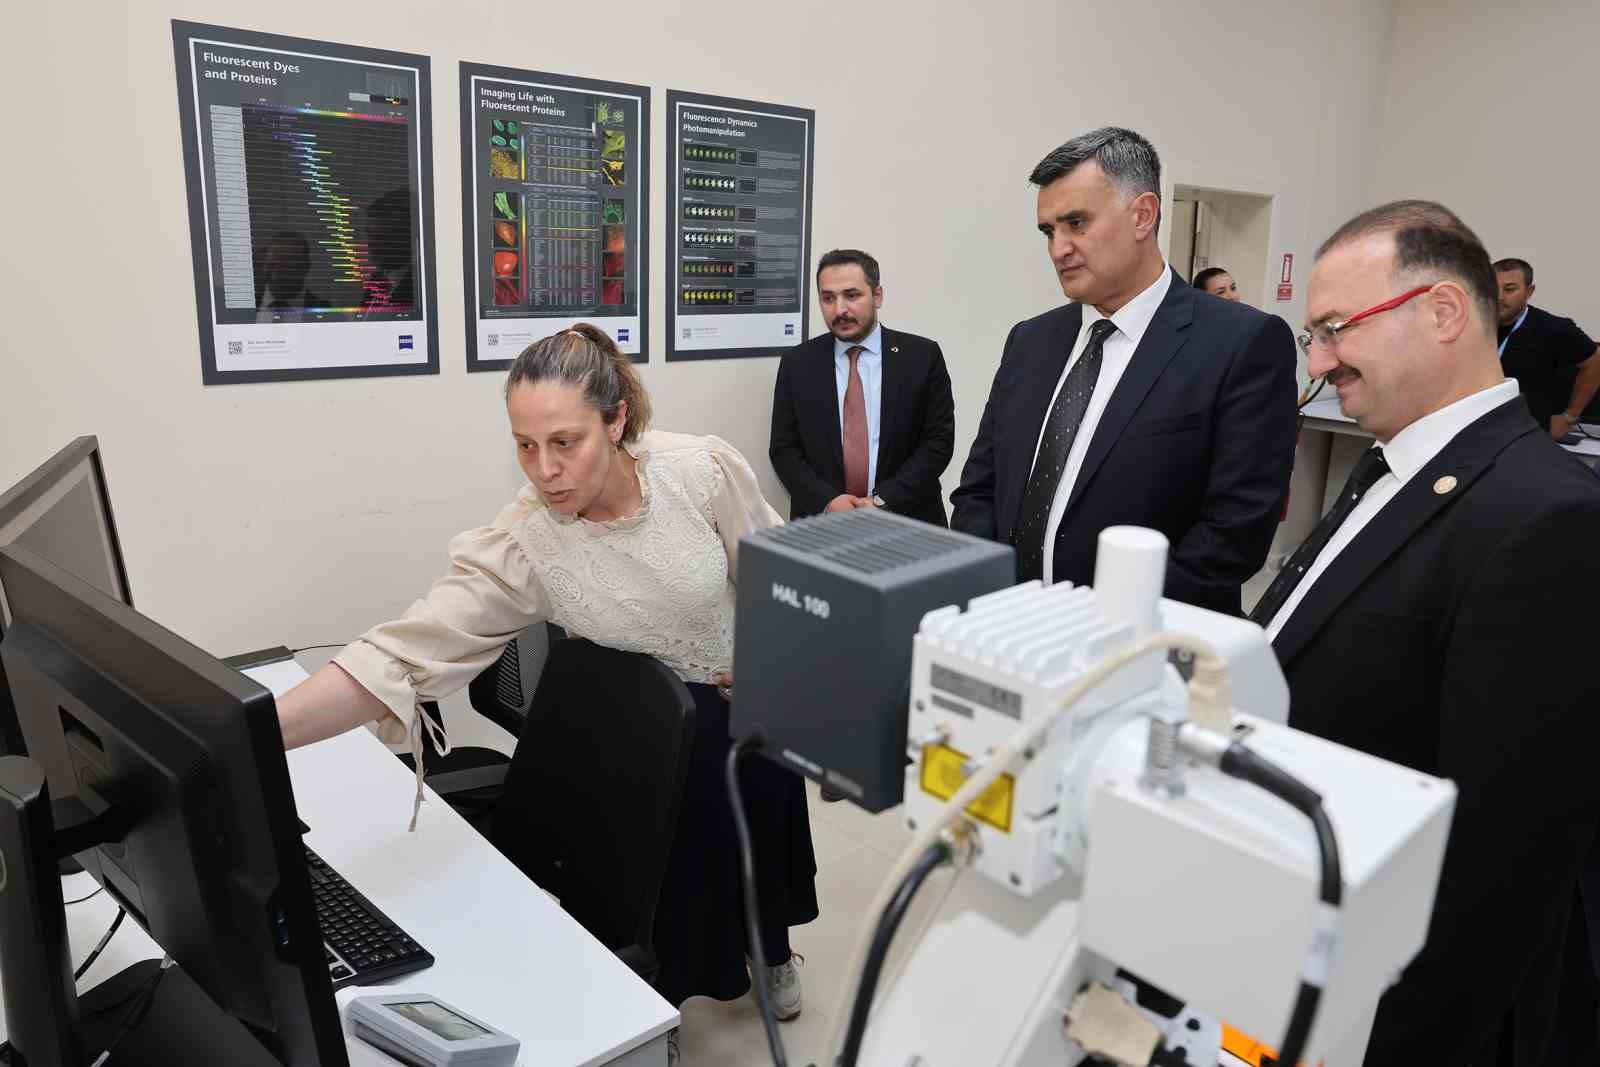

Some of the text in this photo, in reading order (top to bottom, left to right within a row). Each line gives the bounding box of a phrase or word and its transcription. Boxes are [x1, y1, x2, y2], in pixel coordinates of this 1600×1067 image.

[203, 51, 300, 74] Fluorescent Dyes
[204, 69, 277, 86] and Proteins
[480, 87, 555, 104] Imaging Life with
[481, 99, 566, 117] Fluorescent Proteins
[683, 111, 758, 128] Fluorescence Dynamics
[683, 123, 746, 137] Photomanipulation
[772, 582, 830, 619] HAL 100
